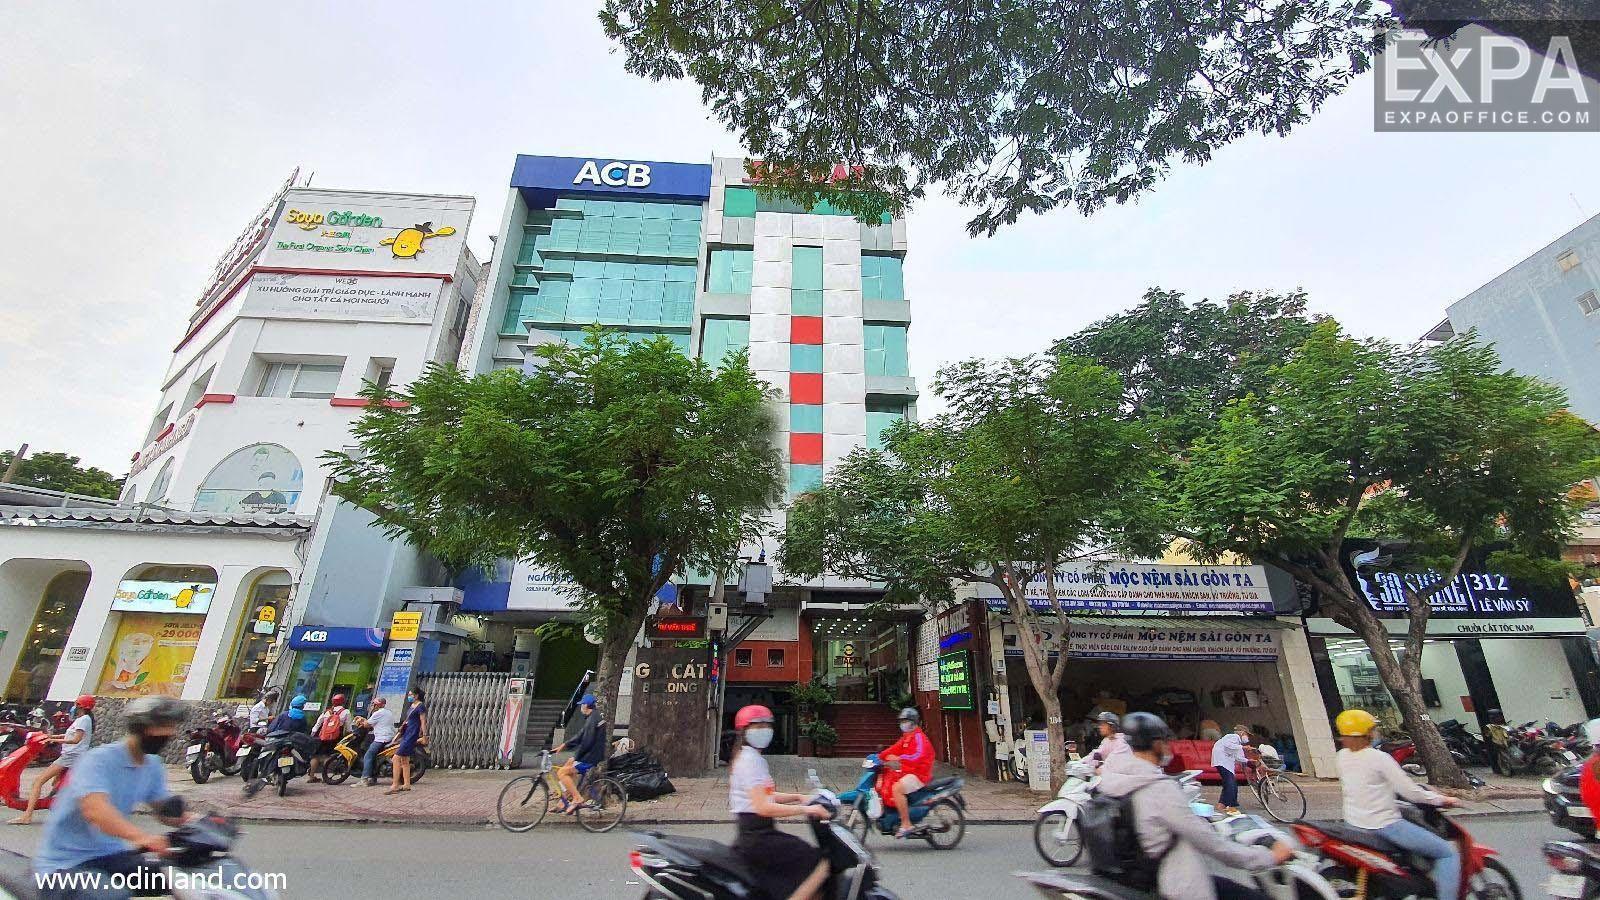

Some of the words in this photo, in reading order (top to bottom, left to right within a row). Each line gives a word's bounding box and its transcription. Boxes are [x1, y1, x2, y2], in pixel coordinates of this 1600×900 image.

[573, 161, 651, 187] ACB
[286, 210, 324, 225] Soya
[1109, 568, 1140, 588] MỘC
[1142, 569, 1172, 588] NỆM
[1174, 569, 1199, 587] SÀI
[1200, 569, 1231, 587] GÒN
[1470, 574, 1508, 590] 312
[1479, 598, 1494, 611] LÊ
[1493, 598, 1515, 611] VĂN
[301, 631, 328, 641] ACB
[1169, 631, 1196, 643] NỆM
[1200, 631, 1221, 641] SÀI
[1225, 631, 1251, 642] GÒN
[672, 659, 707, 679] CÁT
[643, 682, 699, 693] BDING
